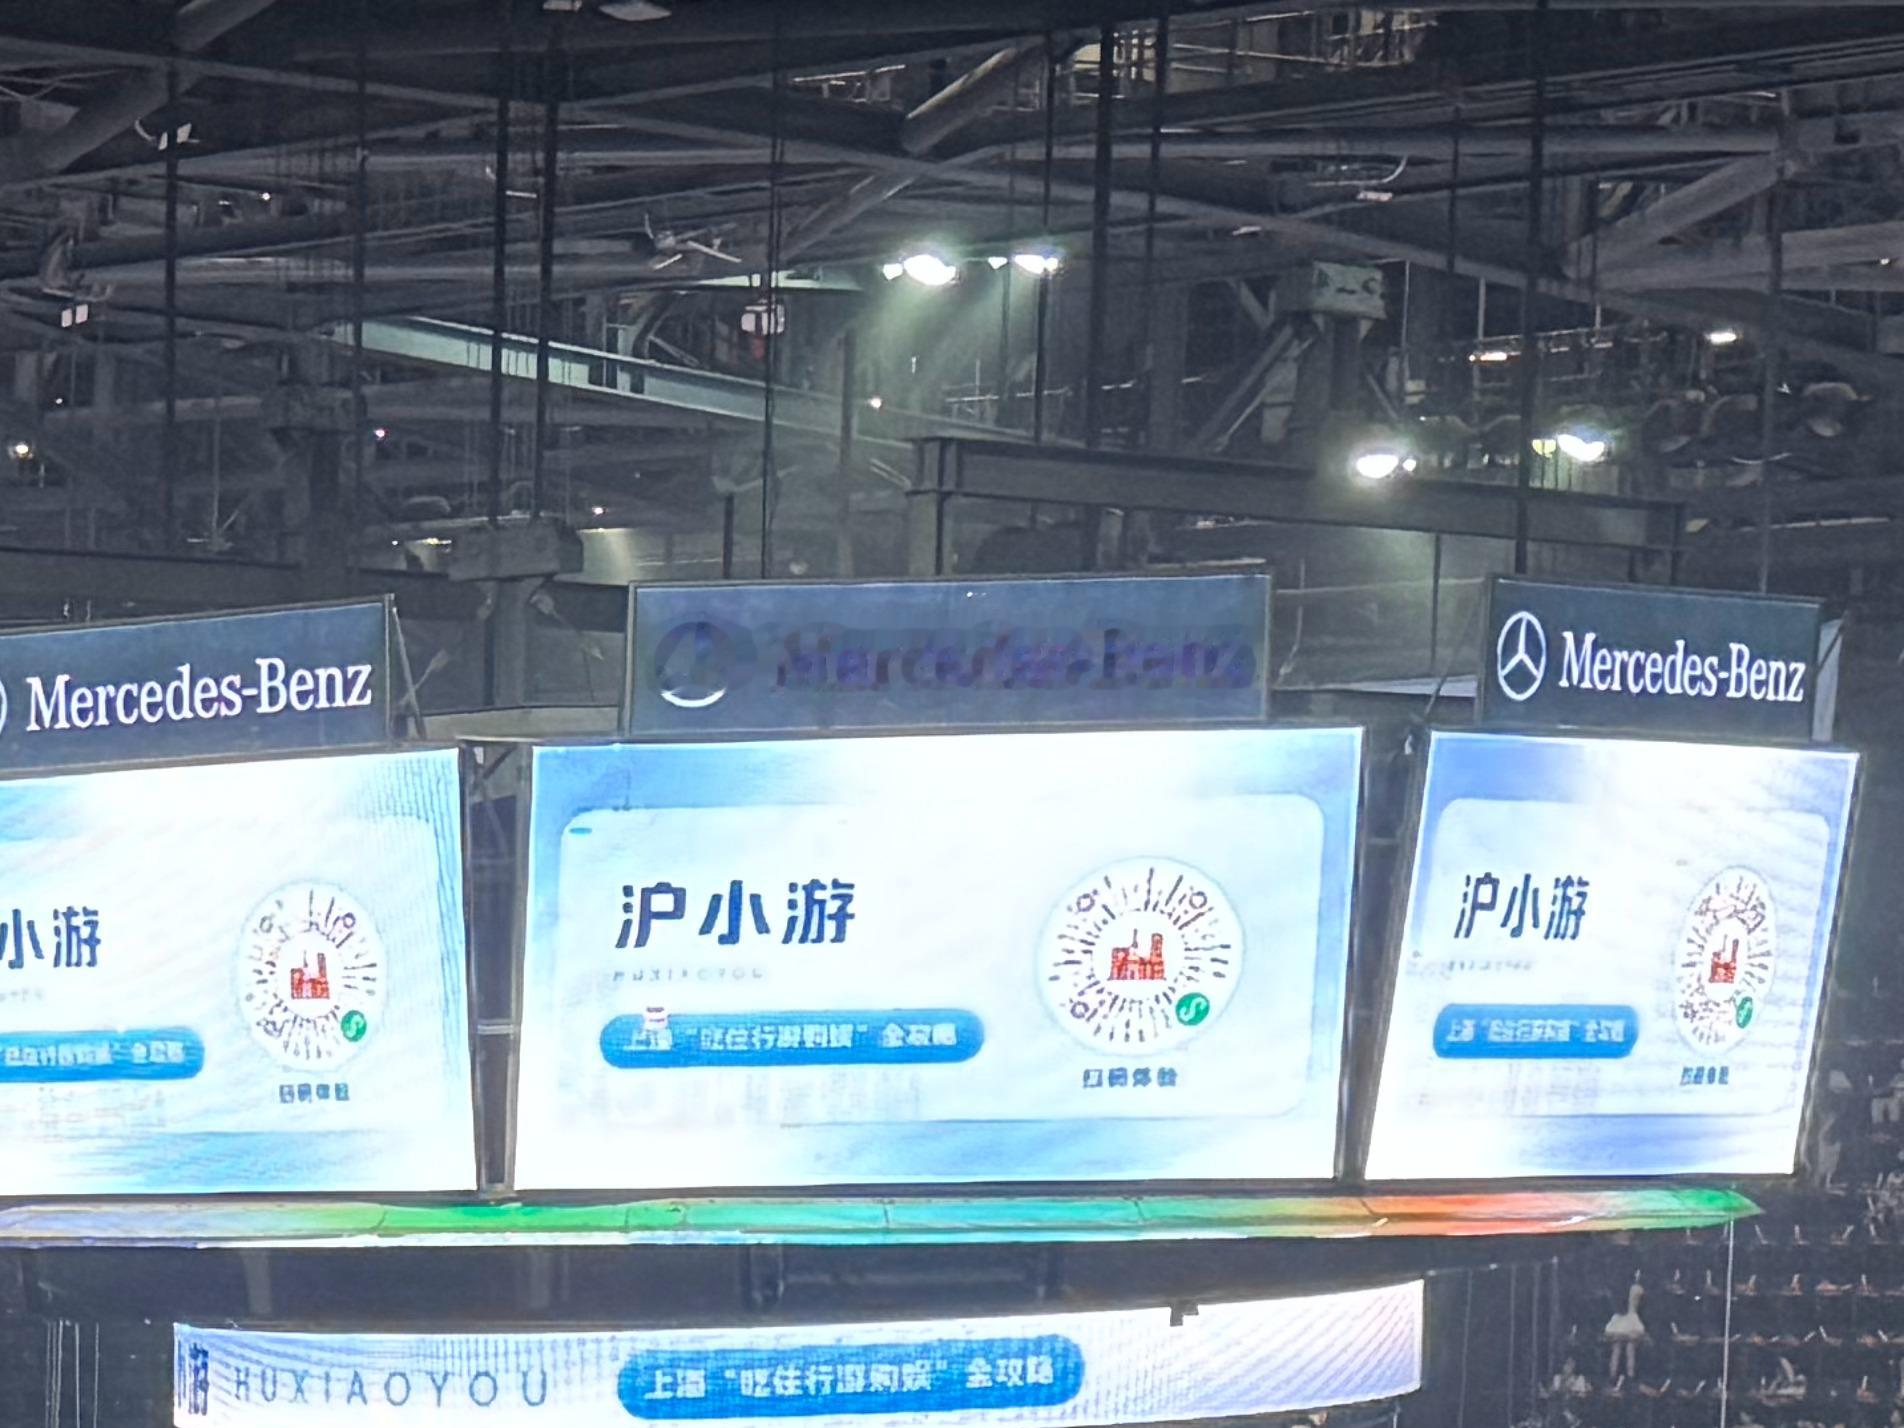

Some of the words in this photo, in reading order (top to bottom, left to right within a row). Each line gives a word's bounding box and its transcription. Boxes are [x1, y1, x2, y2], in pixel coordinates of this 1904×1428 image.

[26, 656, 373, 731] Mercedes-Benz
[1559, 632, 1806, 702] Mercedes-Benz
[615, 879, 856, 948] 沪小游
[1453, 873, 1590, 940] 沪小游
[234, 1366, 548, 1408] HUXIAOYOU
[645, 1368, 706, 1400] 上海
[965, 1355, 1054, 1390] 全攻略
